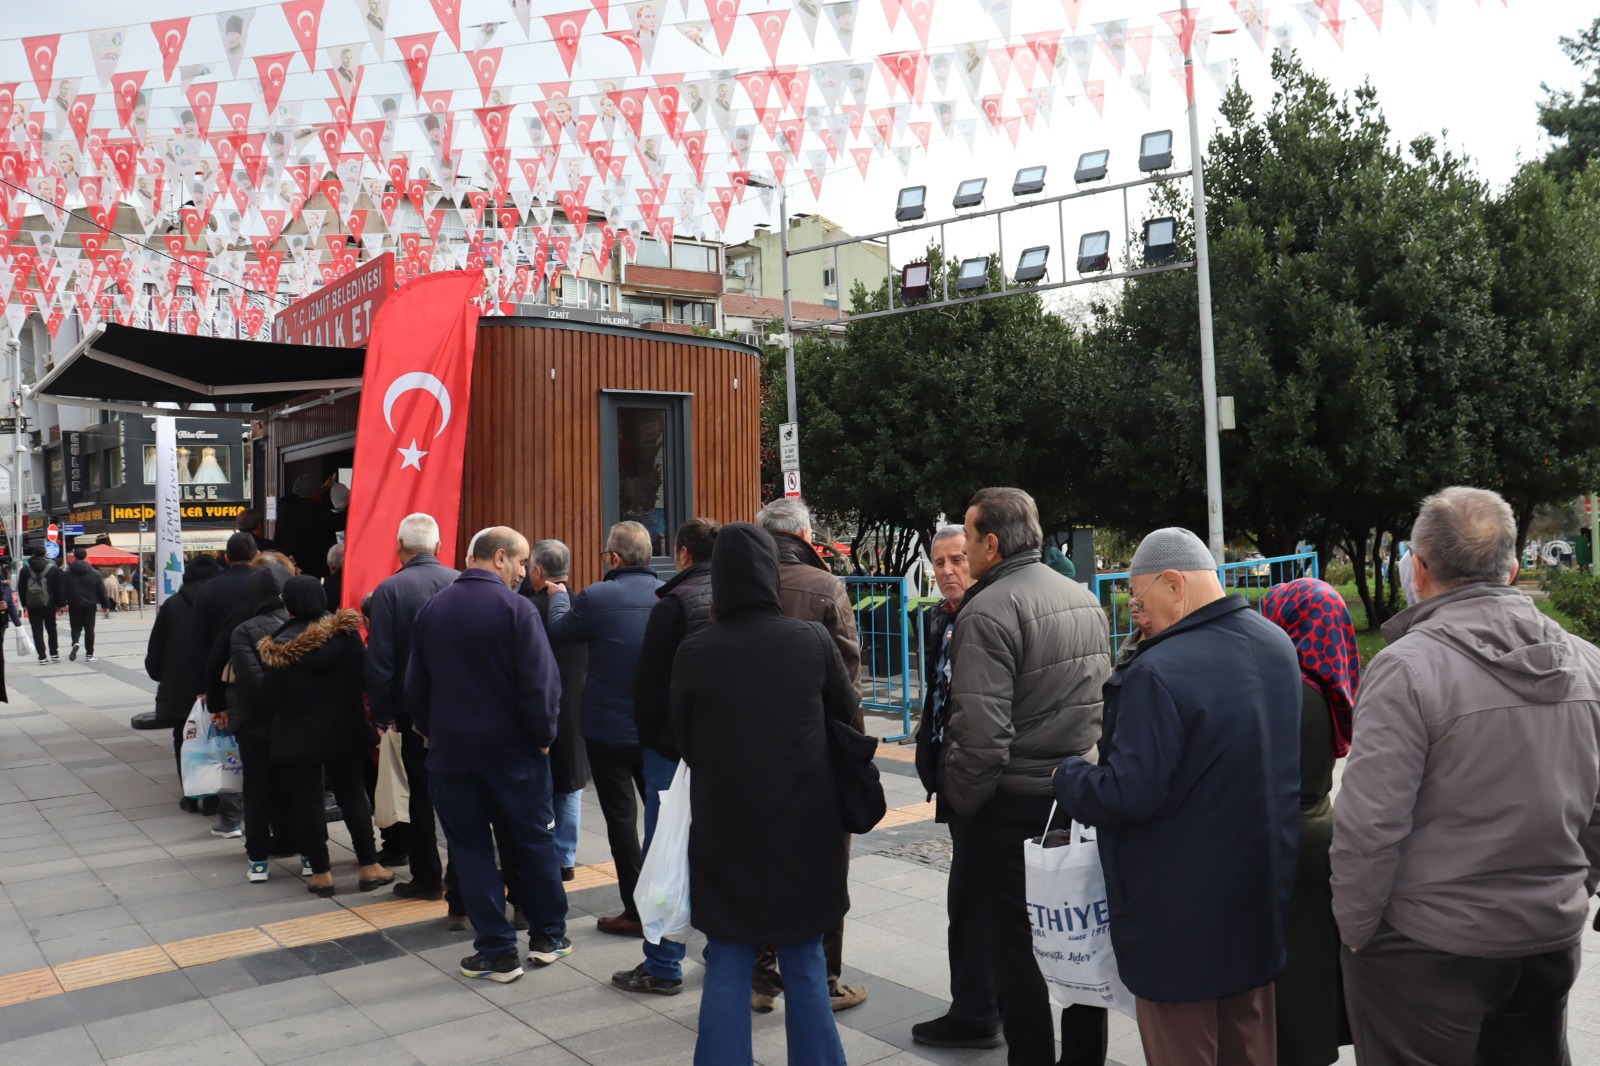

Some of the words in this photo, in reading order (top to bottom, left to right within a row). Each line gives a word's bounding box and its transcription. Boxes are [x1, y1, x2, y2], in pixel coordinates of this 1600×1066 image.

[308, 291, 330, 323] İZMİT
[331, 261, 382, 310] BELEDİYESİ
[548, 308, 570, 319] İZMİT
[600, 314, 629, 325] İYİLERİN
[302, 312, 345, 347] HALK
[351, 299, 372, 343] ET
[115, 507, 141, 519] HAS
[206, 505, 246, 517] YUFKA
[1068, 933, 1087, 942] since
